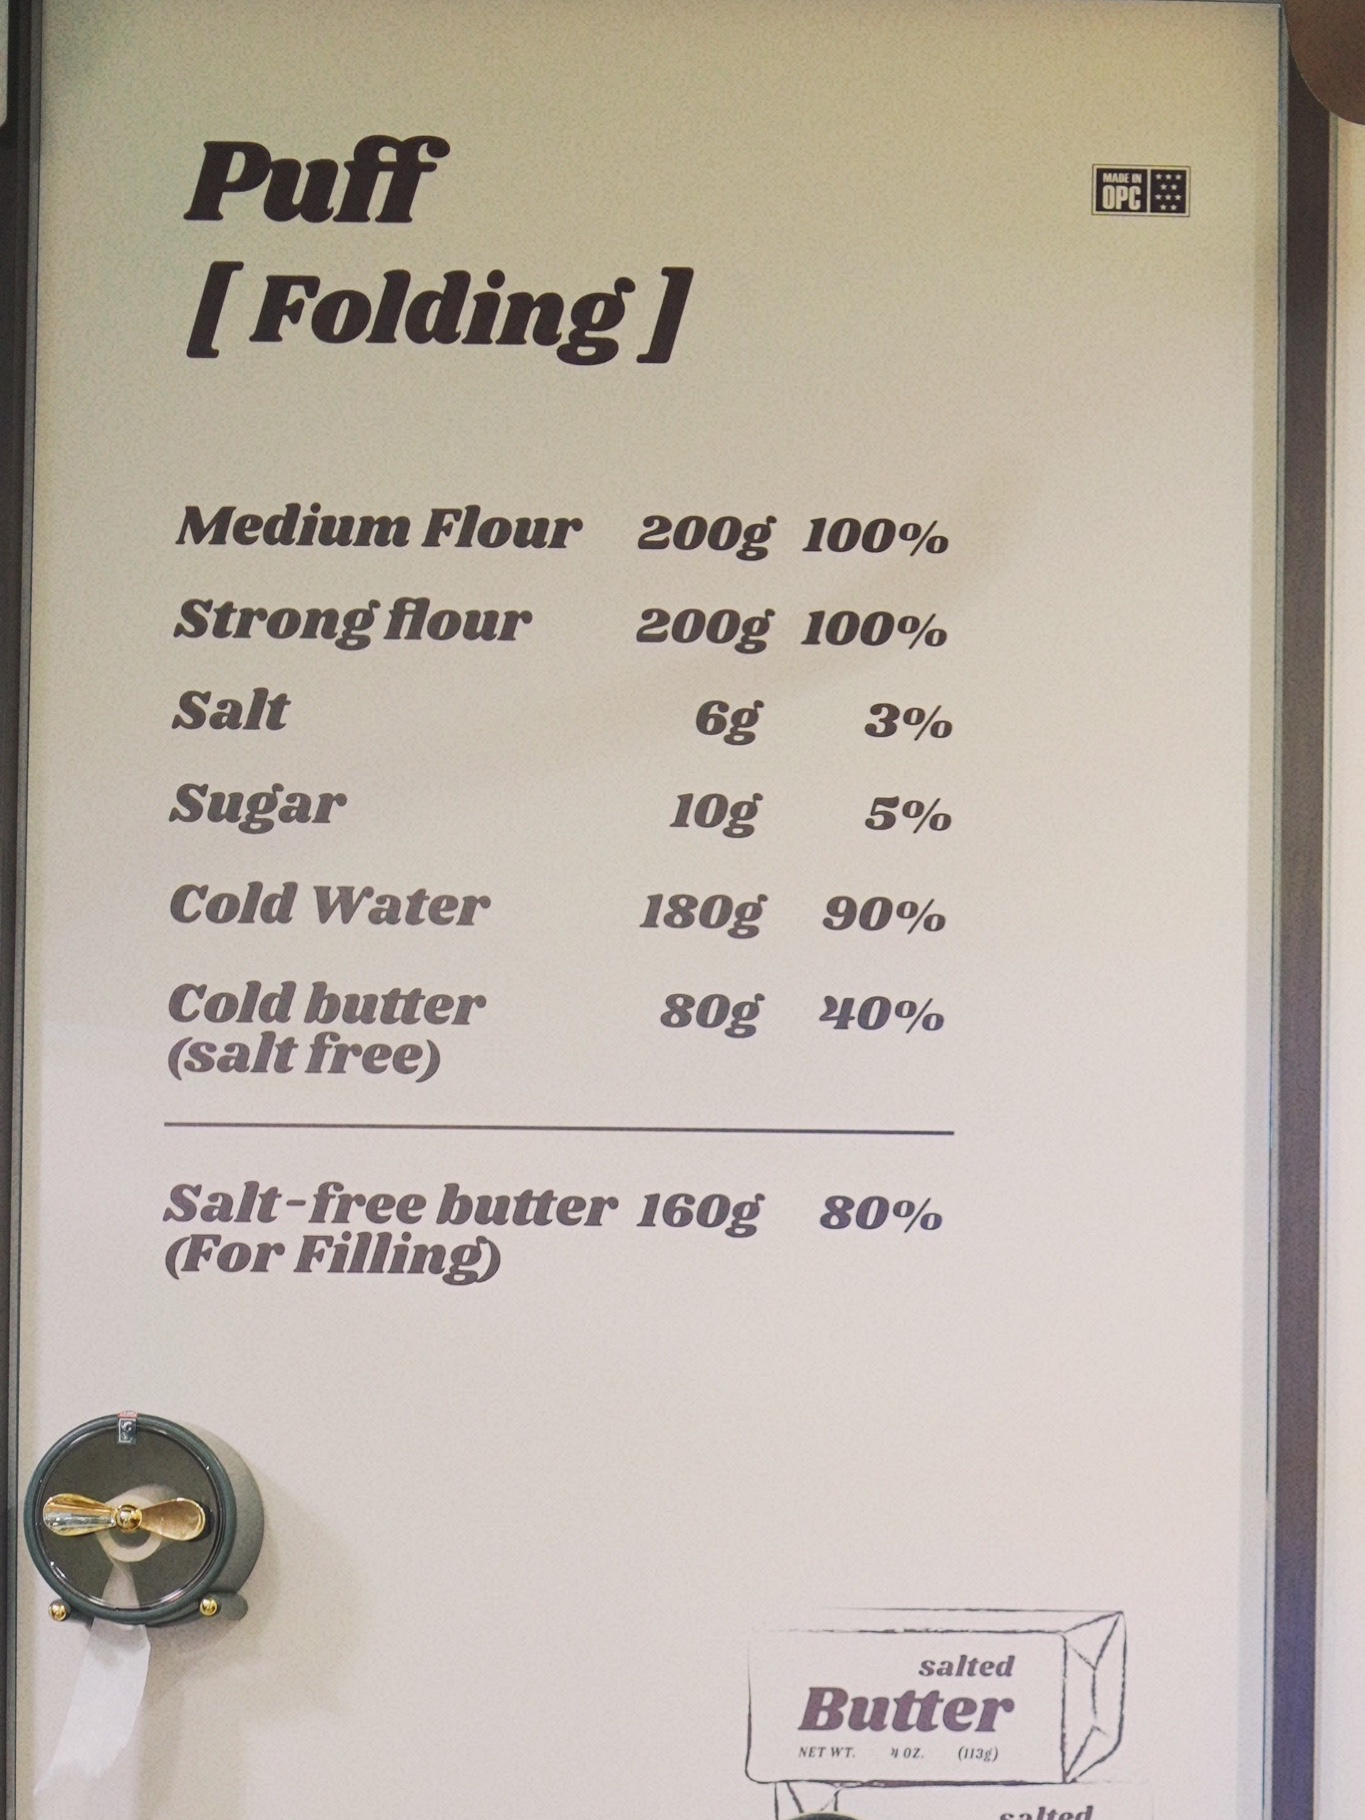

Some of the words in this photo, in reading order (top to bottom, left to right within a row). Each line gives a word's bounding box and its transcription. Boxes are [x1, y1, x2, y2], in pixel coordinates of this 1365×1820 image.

[183, 135, 450, 223] Puff
[1102, 185, 1141, 210] OPC
[1103, 173, 1129, 183] MADE
[1132, 173, 1142, 183] IN
[249, 269, 635, 366] Folding
[175, 502, 410, 547] Medium
[421, 505, 583, 549] Flour
[638, 515, 777, 561] 200g
[803, 518, 948, 556] 100%
[173, 599, 381, 651] Strong
[384, 597, 532, 641] flour
[636, 608, 775, 654] 200g
[801, 611, 947, 649] 100%
[172, 687, 291, 730] Salt
[696, 700, 764, 745] 6g
[865, 703, 952, 741] 3%
[169, 783, 347, 834] Sugar
[670, 793, 763, 838] 10g
[865, 796, 951, 833] 5%
[170, 881, 298, 924] Cold
[313, 886, 491, 926] Water
[640, 894, 768, 939] 180g
[823, 896, 946, 934] 90%
[169, 980, 296, 1023] Cold
[304, 981, 487, 1025] butter
[660, 993, 765, 1038] 80g
[819, 996, 944, 1033] 40%
[168, 1031, 299, 1080] (salt
[305, 1031, 440, 1083] free)
[163, 1181, 426, 1227] Salt-free
[436, 1183, 619, 1226] butter
[637, 1193, 765, 1238] 160g
[820, 1195, 942, 1233] 80%
[165, 1234, 285, 1280] (For
[293, 1231, 501, 1286] Filling)
[919, 1654, 1015, 1677] salted
[798, 1687, 1015, 1732] Butter
[800, 1747, 827, 1758] NET
[831, 1747, 856, 1758] WT.
[958, 1747, 998, 1762] (113g)
